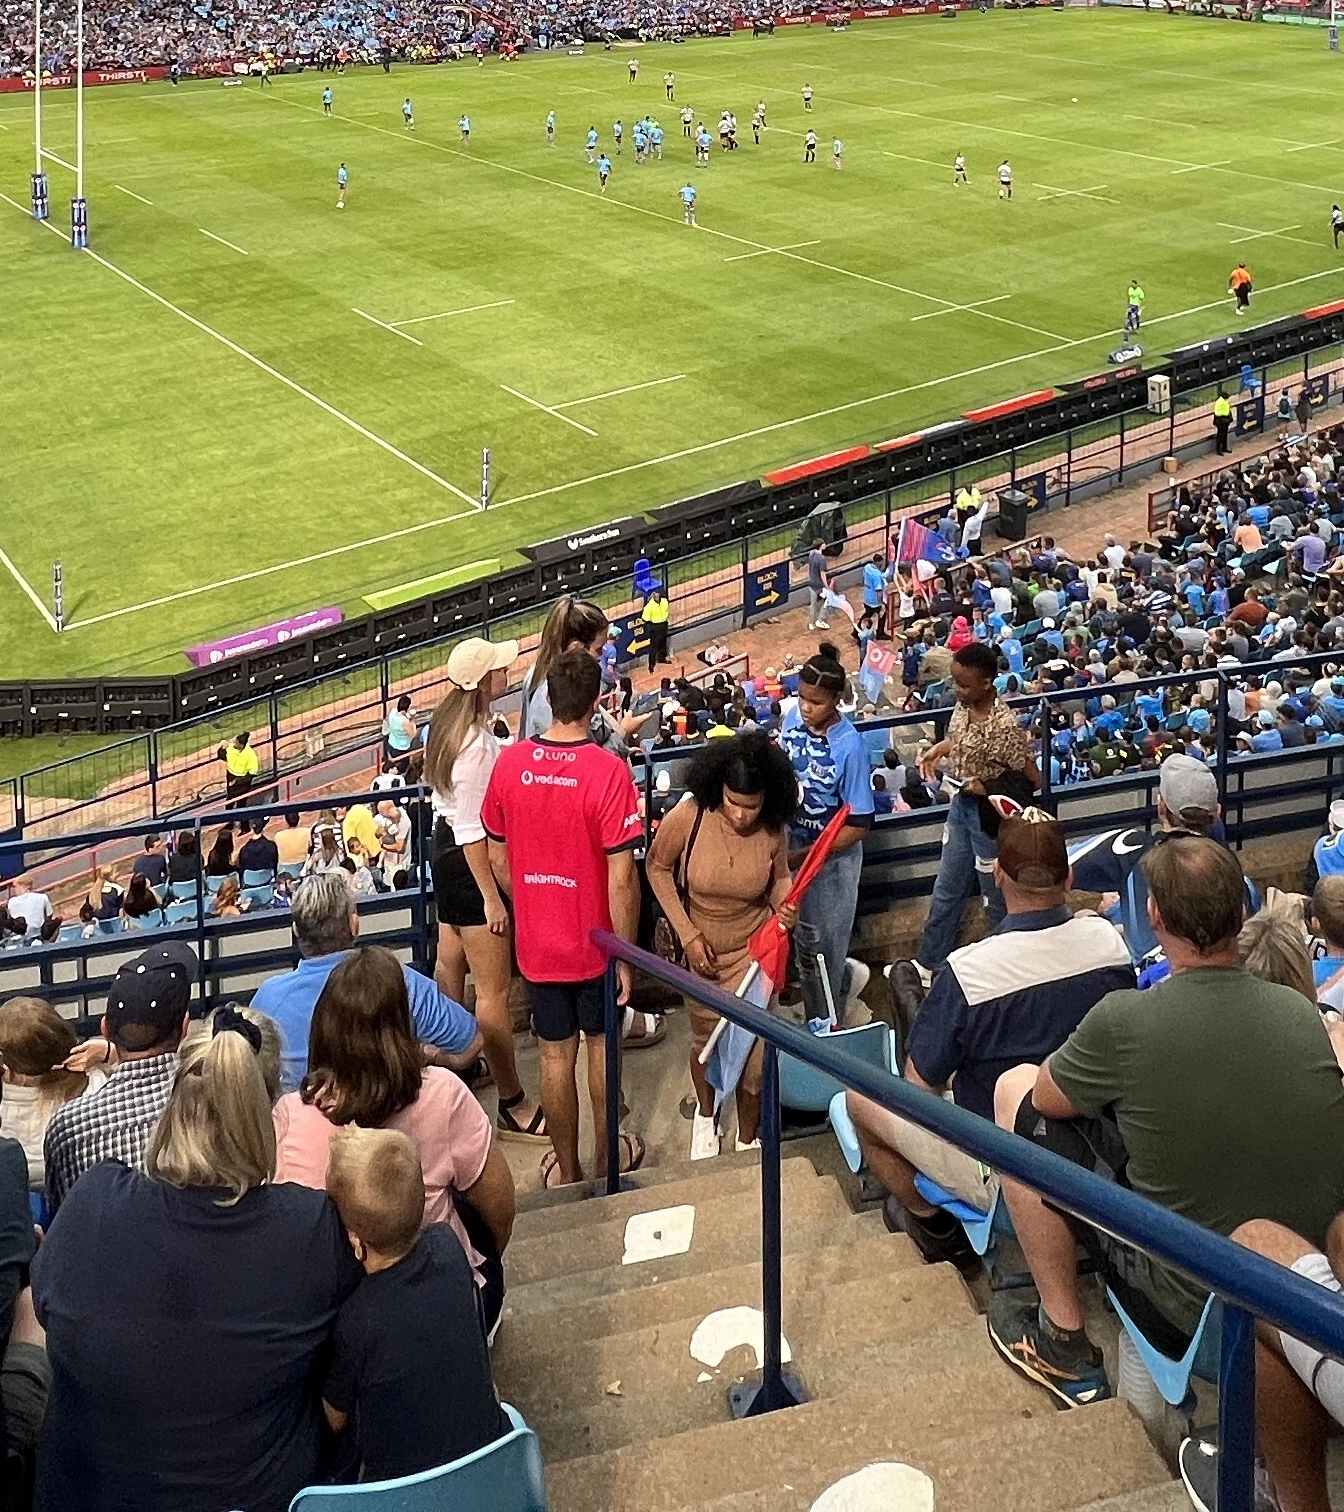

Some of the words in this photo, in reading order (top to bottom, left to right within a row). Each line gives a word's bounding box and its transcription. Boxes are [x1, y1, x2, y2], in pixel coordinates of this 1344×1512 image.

[98, 71, 145, 82] THIRSTI
[546, 751, 577, 763] LUNO
[534, 773, 578, 787] vodacom
[523, 872, 578, 889] BRIGHTROCK
